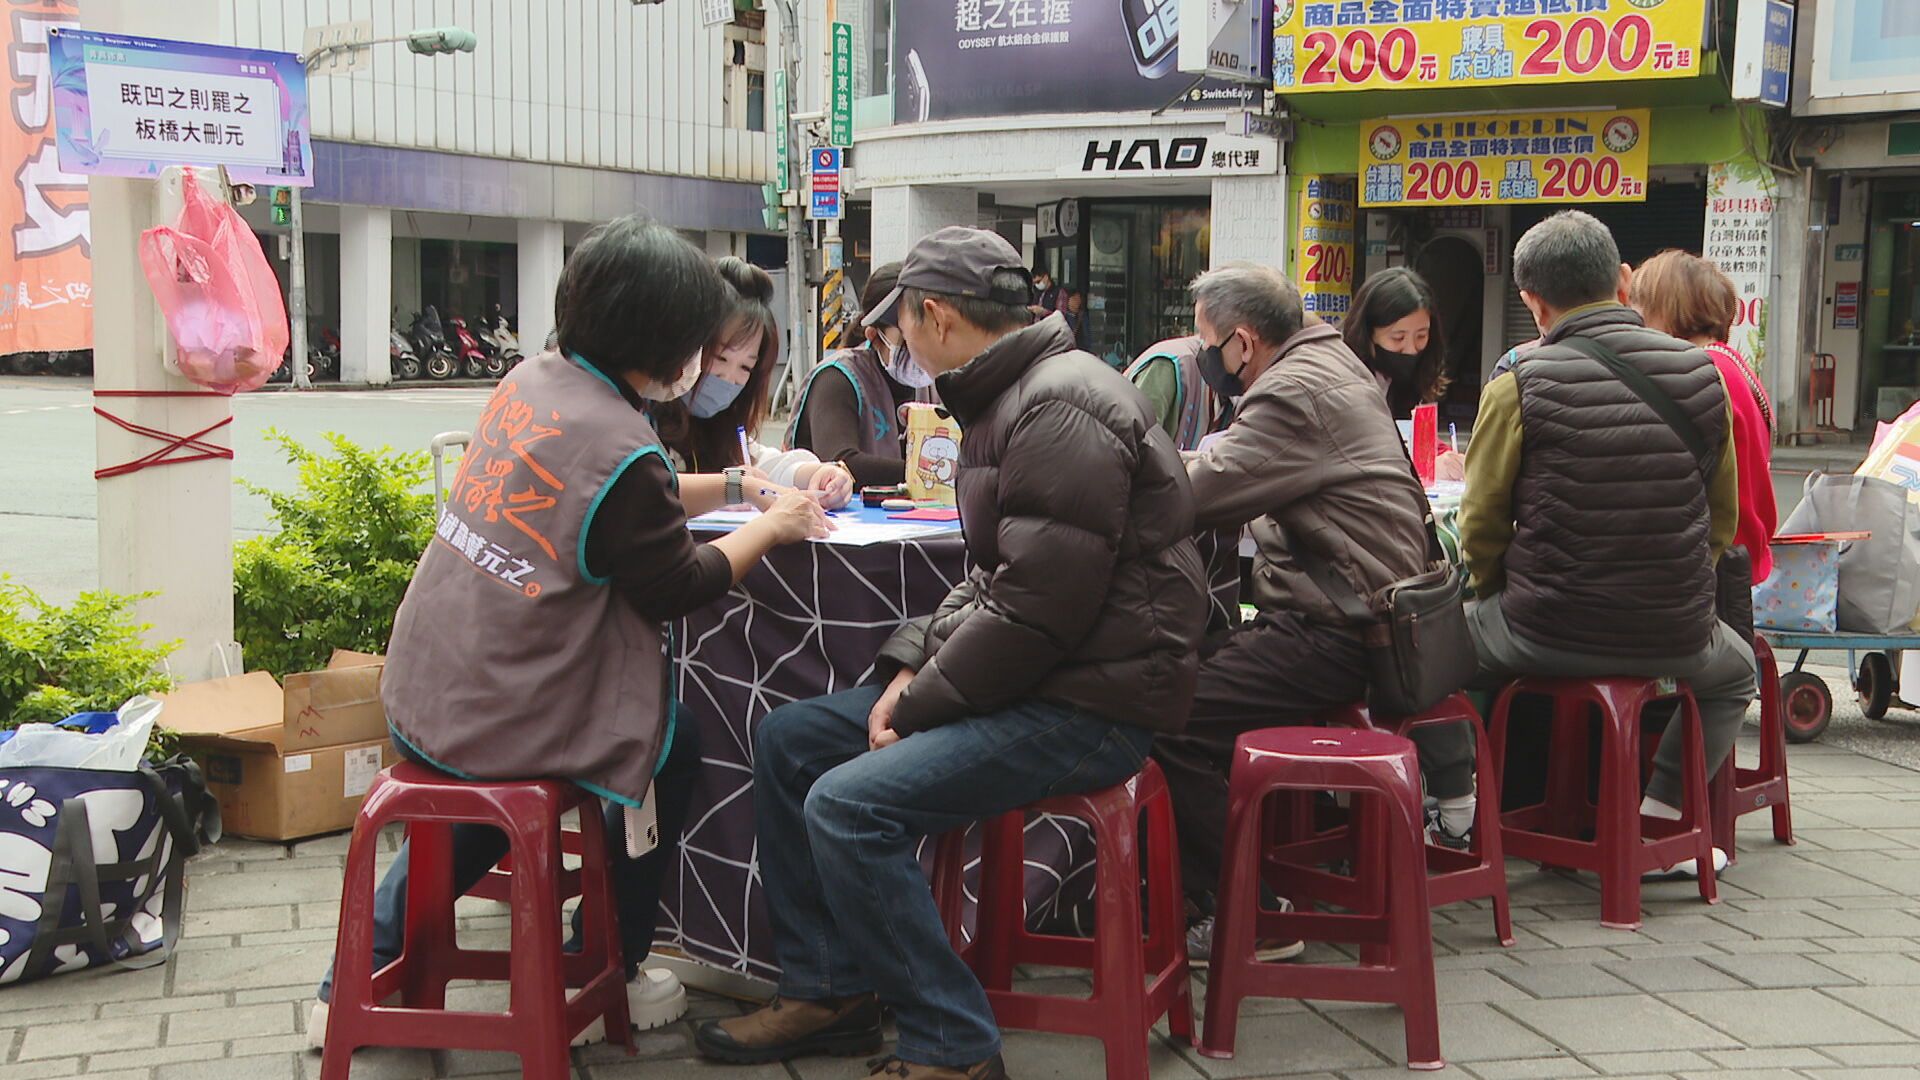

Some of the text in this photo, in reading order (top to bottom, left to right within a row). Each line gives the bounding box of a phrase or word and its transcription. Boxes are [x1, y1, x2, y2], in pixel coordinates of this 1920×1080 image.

[958, 36, 996, 50] ODYSSEY
[836, 36, 849, 112] 館前東路
[1209, 50, 1239, 70] HAO
[1449, 50, 1514, 80] 床包組
[120, 82, 252, 116] 既凹之則罷之
[135, 117, 244, 147] 板橋大刪元
[1415, 116, 1589, 139] SHIBORDIN
[1082, 138, 1259, 171] HAO 總代理
